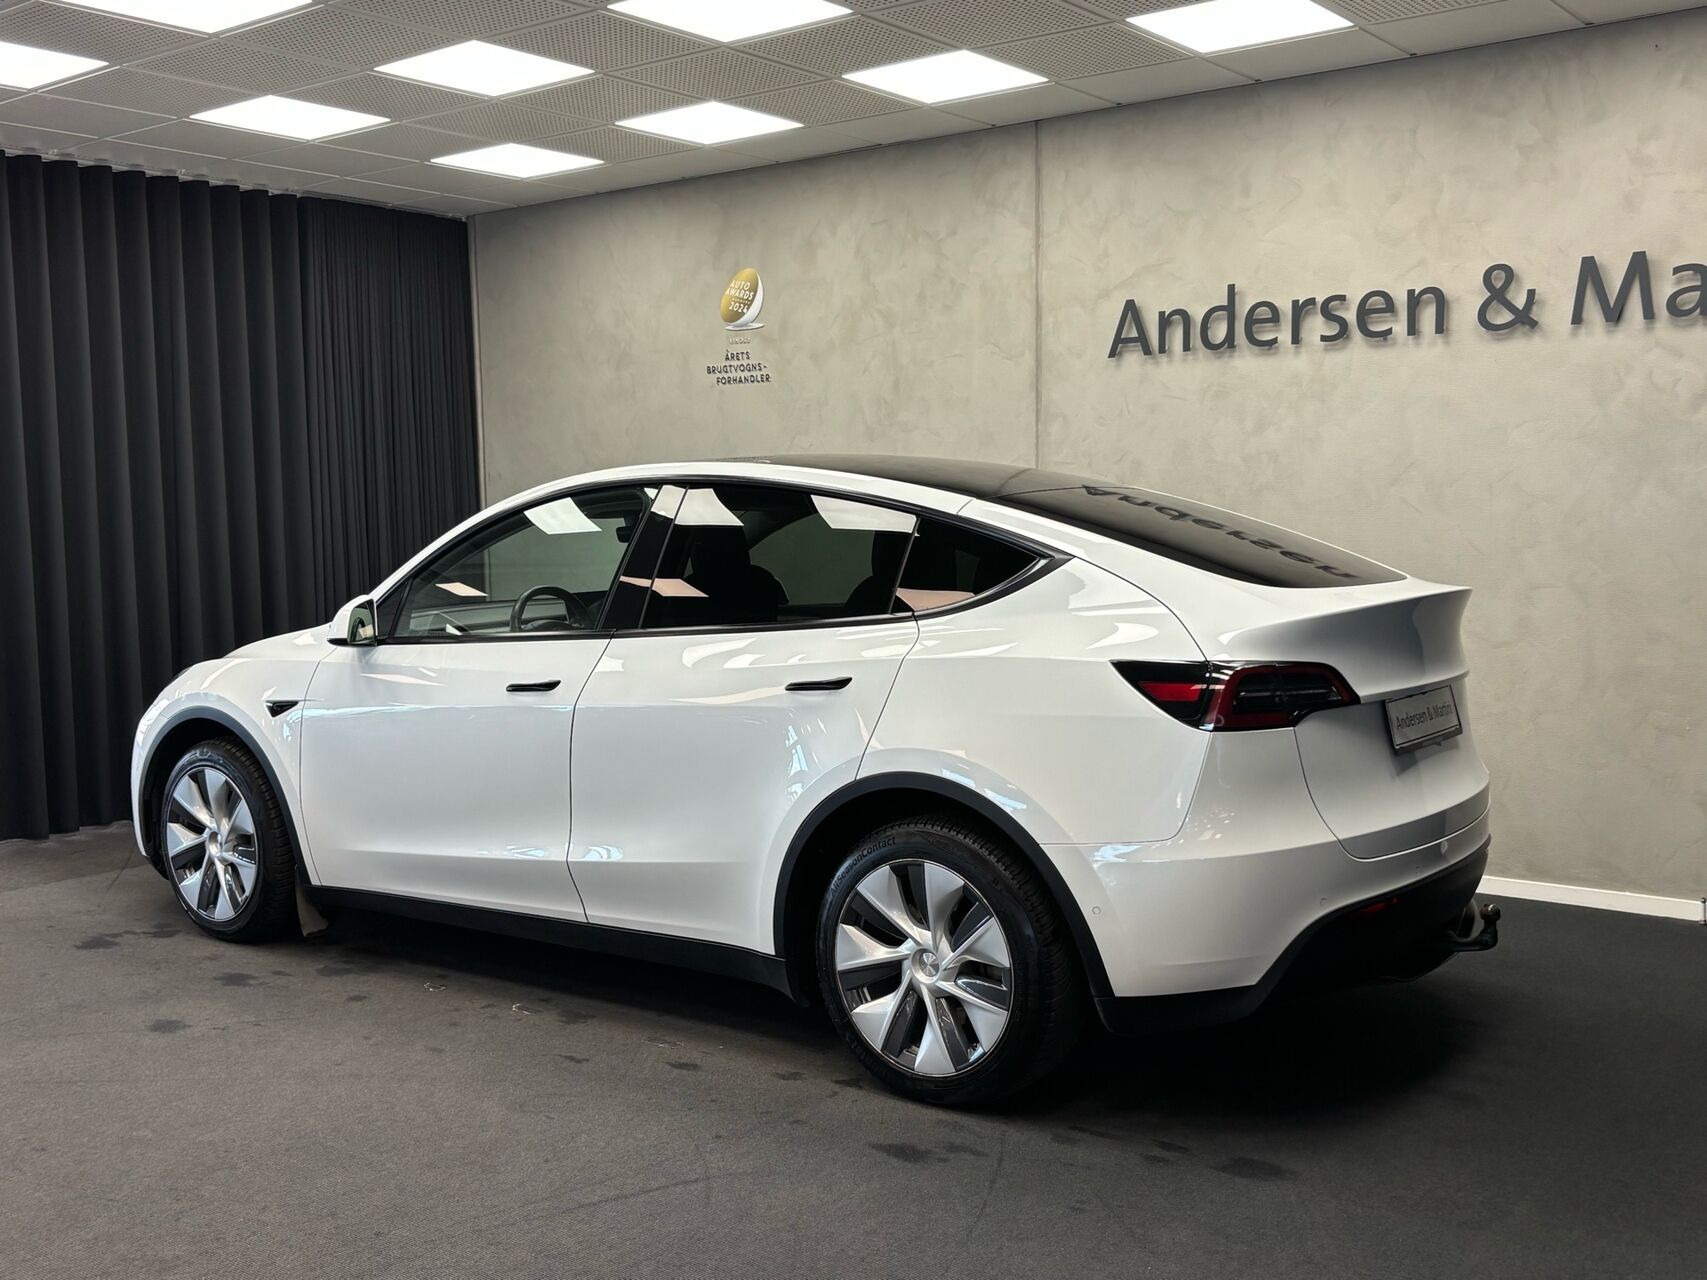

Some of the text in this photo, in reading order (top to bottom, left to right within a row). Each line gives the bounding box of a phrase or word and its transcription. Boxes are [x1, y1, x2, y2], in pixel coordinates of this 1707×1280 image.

[730, 280, 750, 290] AUTO
[726, 288, 754, 300] AWARDS
[729, 301, 748, 313] 2024
[1107, 250, 1707, 358] Andersen & Ma
[725, 349, 751, 361] ÅRETS
[706, 362, 768, 375] BRUGTVOGNS-
[716, 373, 771, 386] FORHANDLER
[1396, 711, 1427, 730] Andersen
[1426, 706, 1434, 720] &
